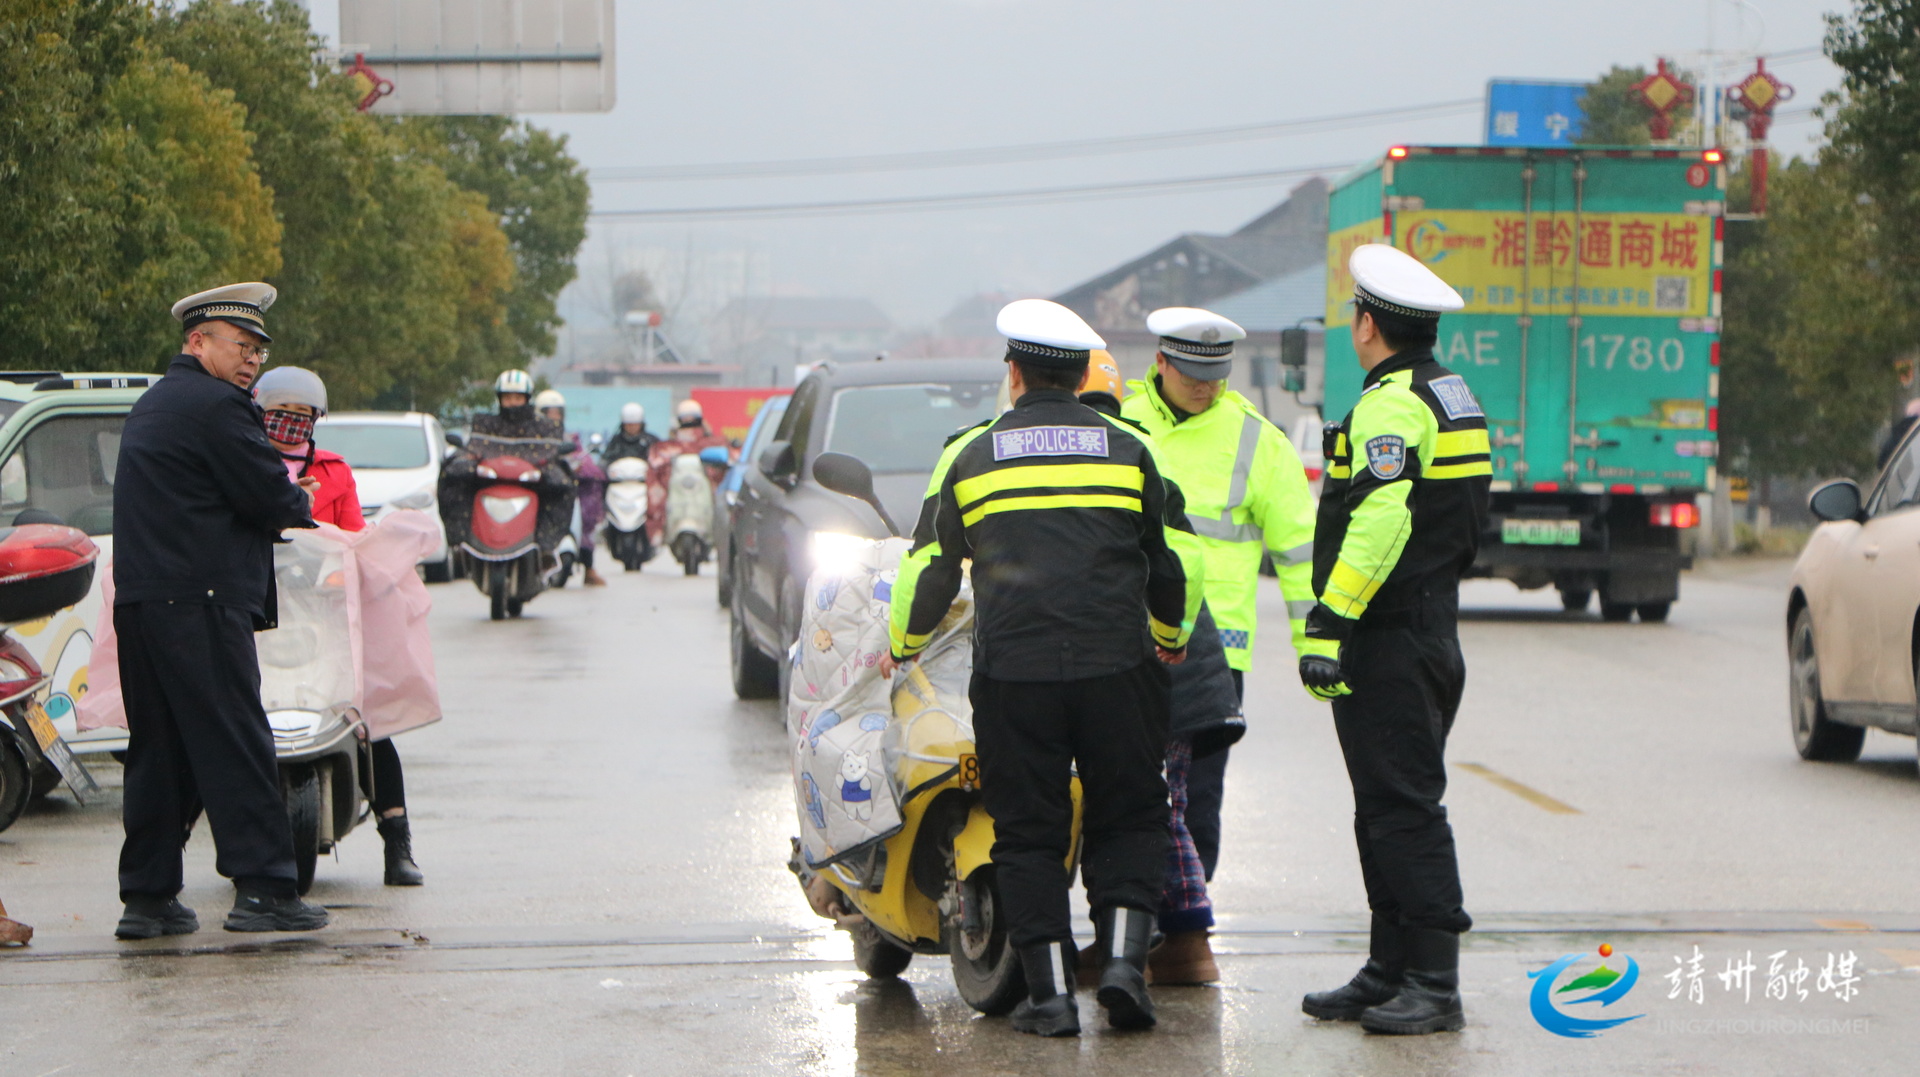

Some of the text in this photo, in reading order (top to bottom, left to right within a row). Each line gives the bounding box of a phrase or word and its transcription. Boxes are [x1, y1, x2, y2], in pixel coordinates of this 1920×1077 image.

[1491, 217, 1698, 269] 湘黔通商城
[1581, 334, 1684, 372] 1780
[1000, 429, 1103, 456] 警POLICE察
